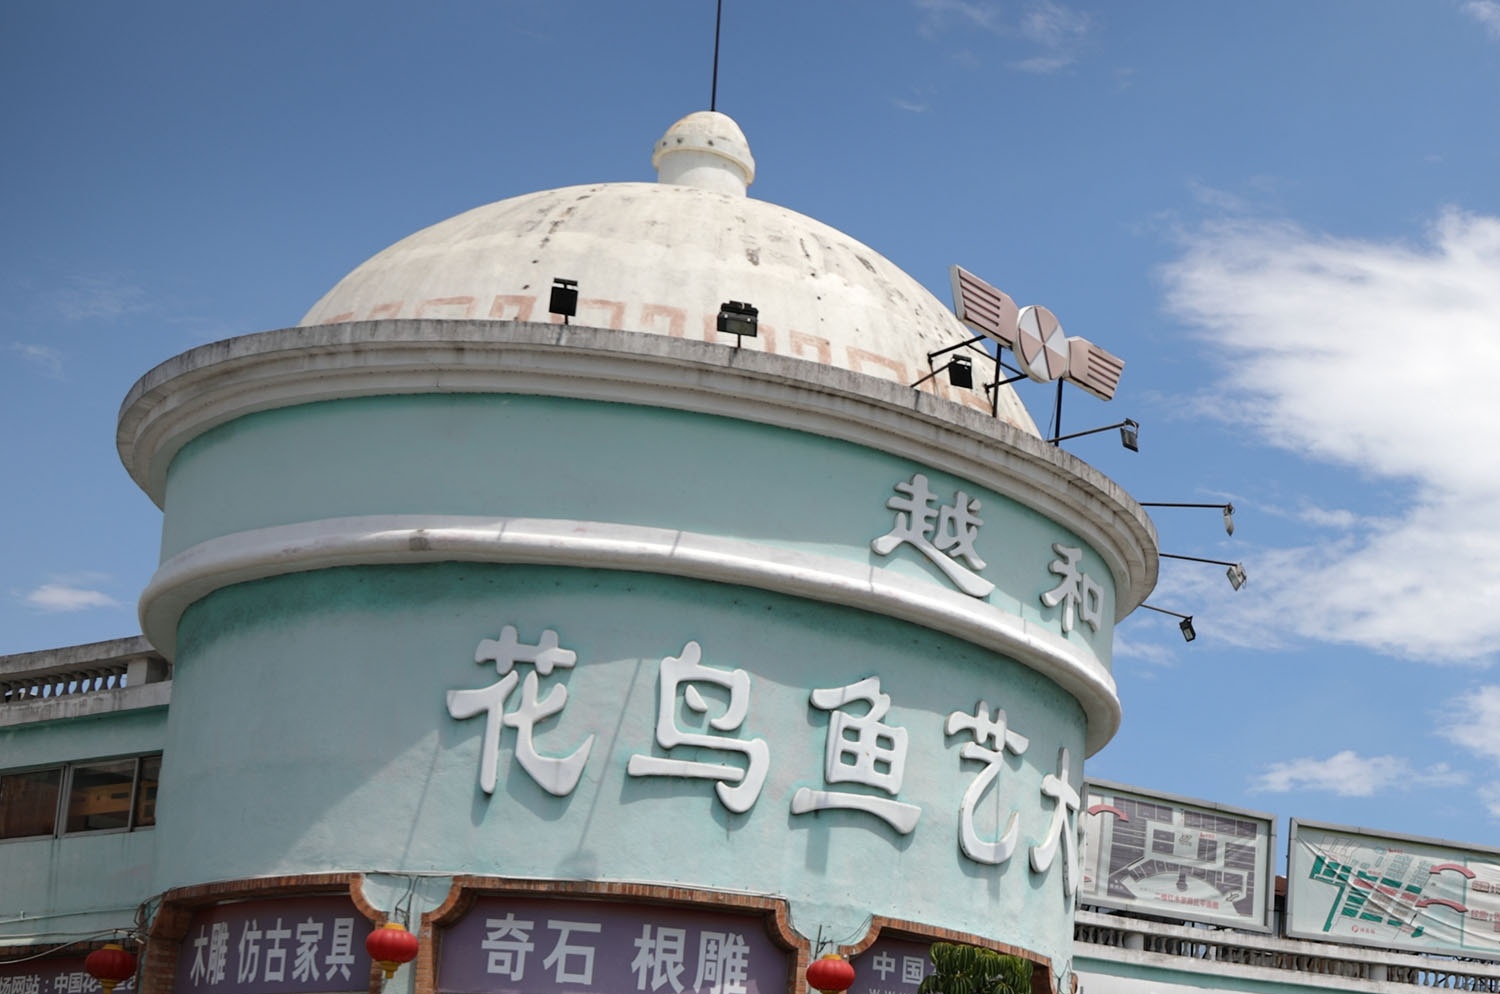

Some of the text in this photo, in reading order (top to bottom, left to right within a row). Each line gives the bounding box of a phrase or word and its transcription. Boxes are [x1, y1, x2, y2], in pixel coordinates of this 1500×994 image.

[871, 473, 1104, 633] 越和
[190, 916, 355, 986] 木雕 仿古家具
[481, 913, 602, 986] 奇石
[872, 951, 933, 985] 中国
